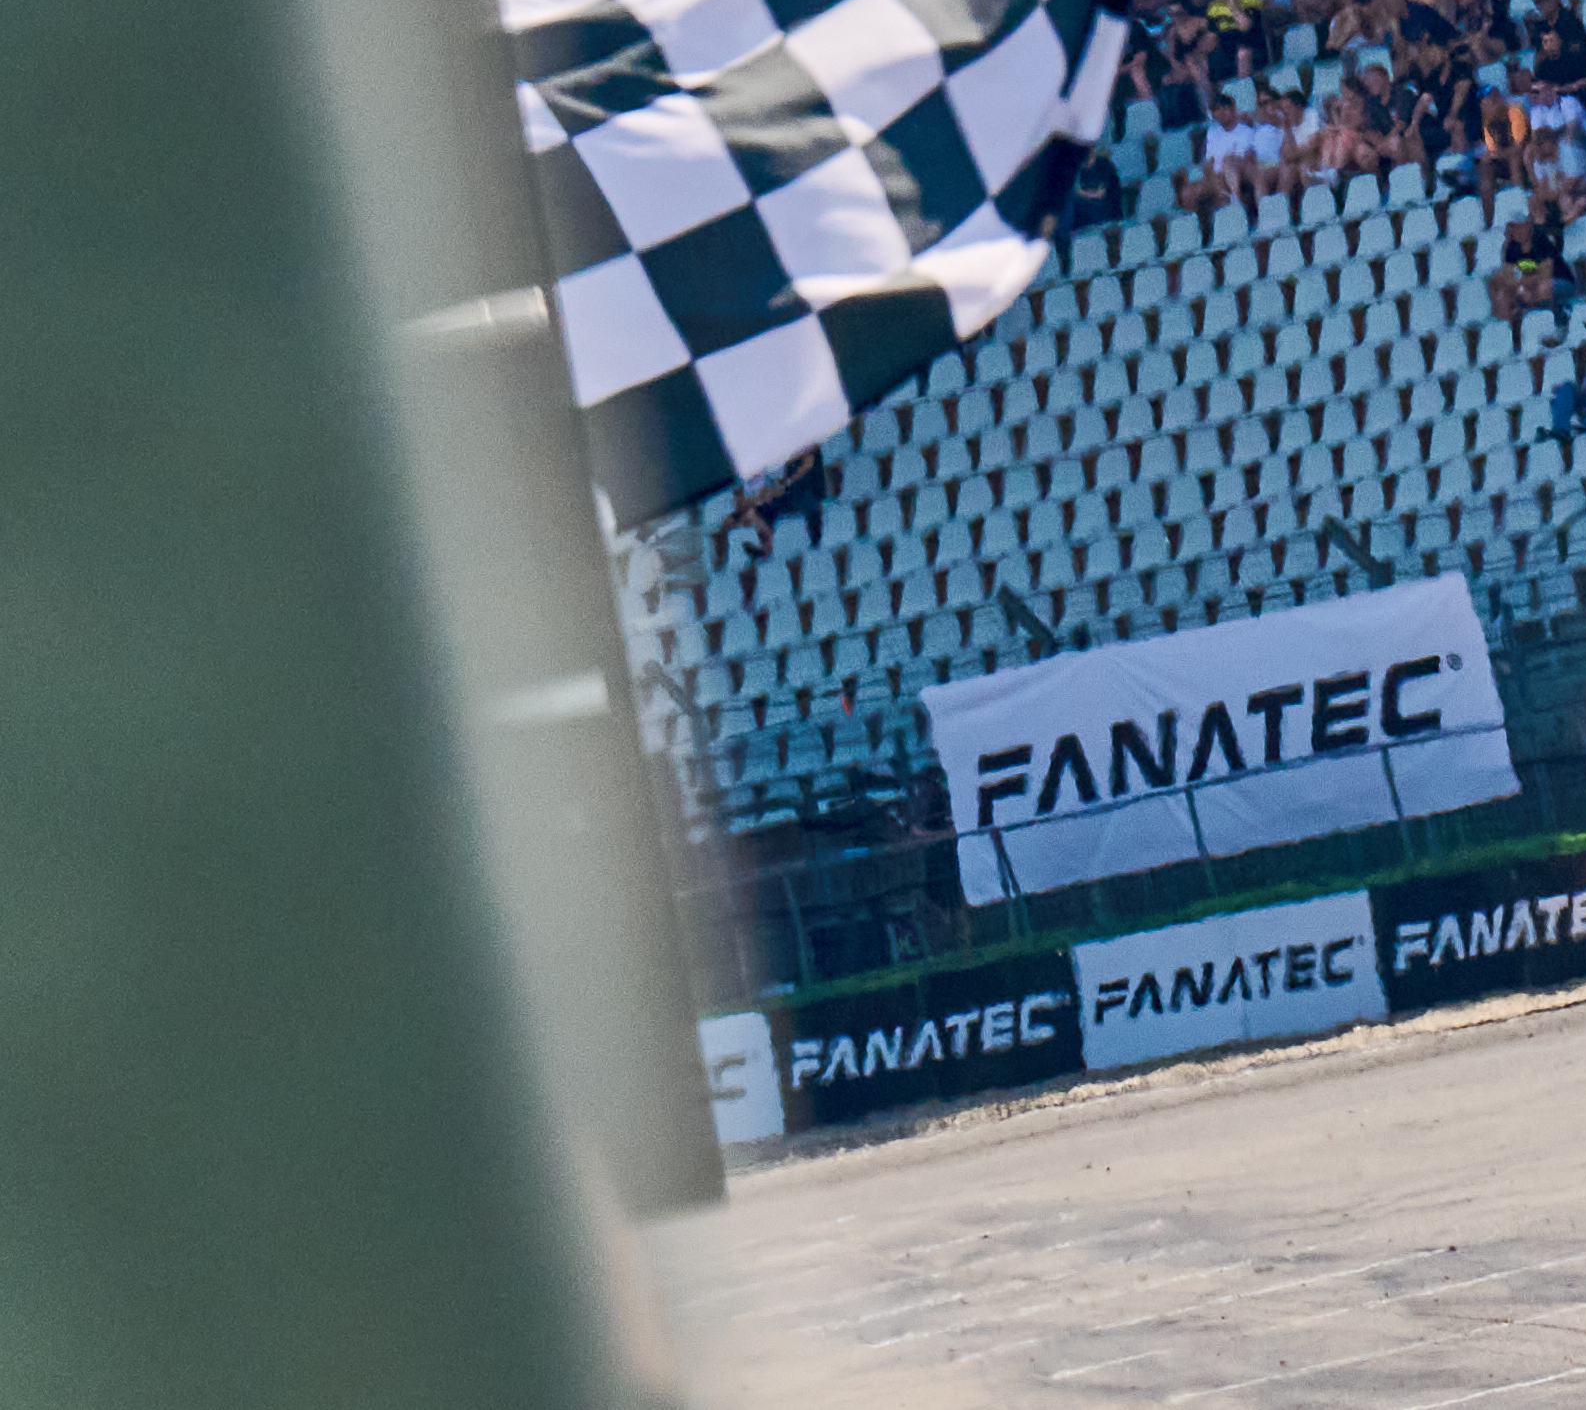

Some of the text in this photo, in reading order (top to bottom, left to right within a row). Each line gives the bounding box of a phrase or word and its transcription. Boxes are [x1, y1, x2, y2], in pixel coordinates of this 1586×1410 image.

[977, 655, 1442, 827] FANATEC
[1094, 936, 1358, 1025] FANATEC
[789, 991, 1060, 1089] FANATEC
